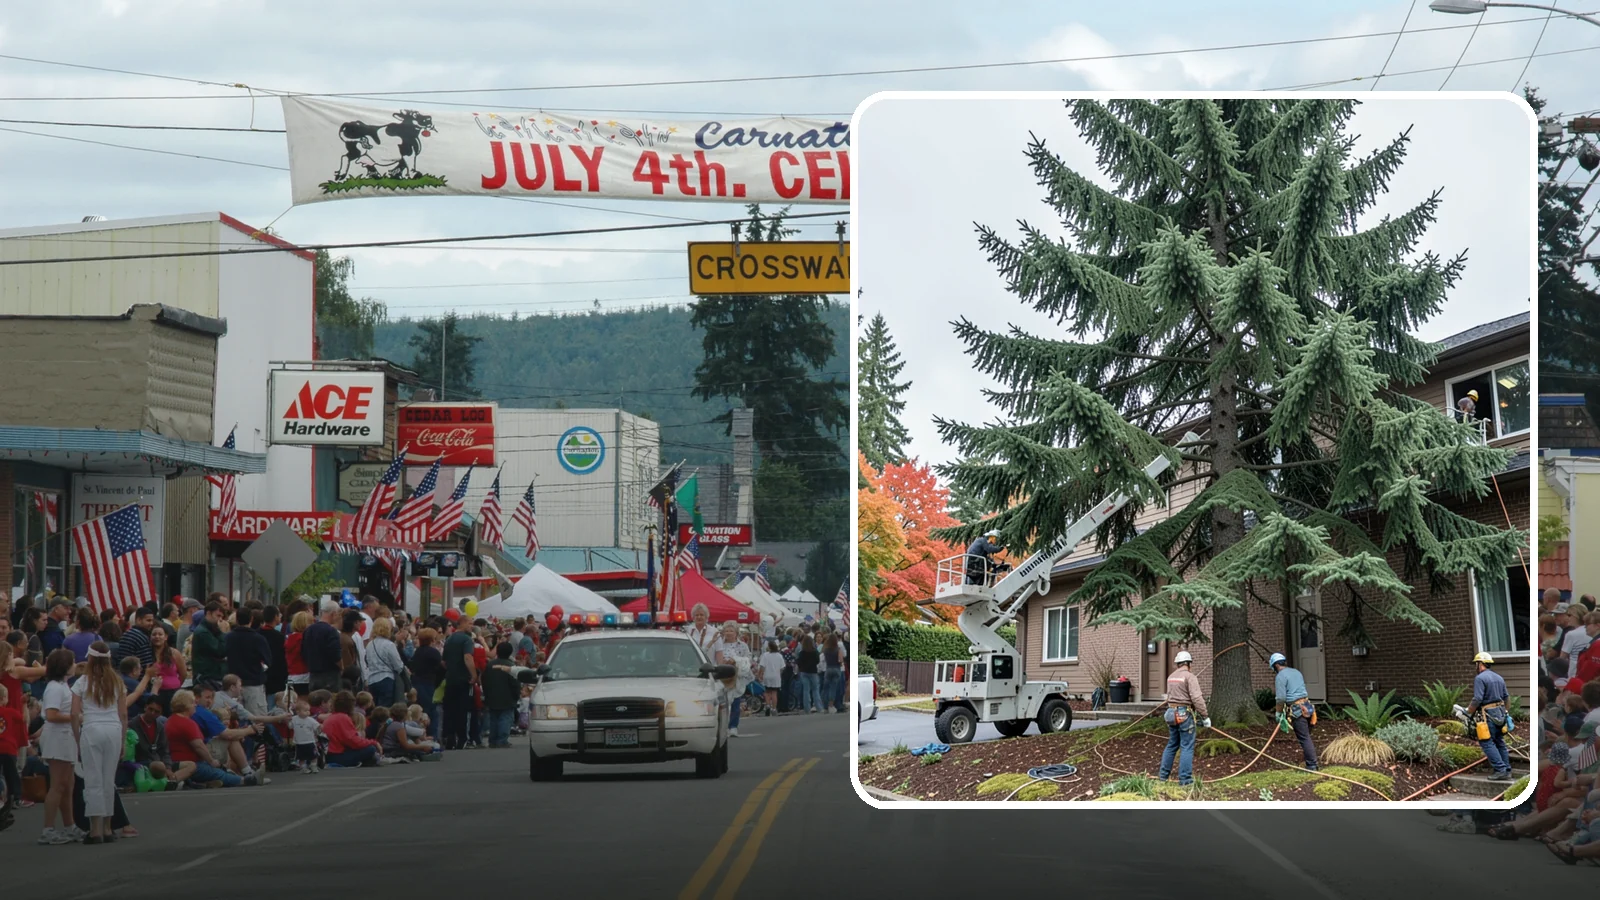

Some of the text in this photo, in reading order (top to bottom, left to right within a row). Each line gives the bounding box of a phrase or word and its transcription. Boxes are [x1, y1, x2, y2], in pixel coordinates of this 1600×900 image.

[481, 141, 605, 192] JULY
[632, 150, 746, 197] 4th.
[697, 254, 850, 279] CROSSWA
[282, 380, 373, 420] ACE
[406, 409, 452, 421] CEDAR
[283, 421, 370, 436] Hardware
[416, 428, 476, 447] Coca-Cola
[83, 484, 155, 495] St. Vincent de Paul
[688, 526, 741, 535] CRNATION
[699, 535, 730, 543] GLASS
